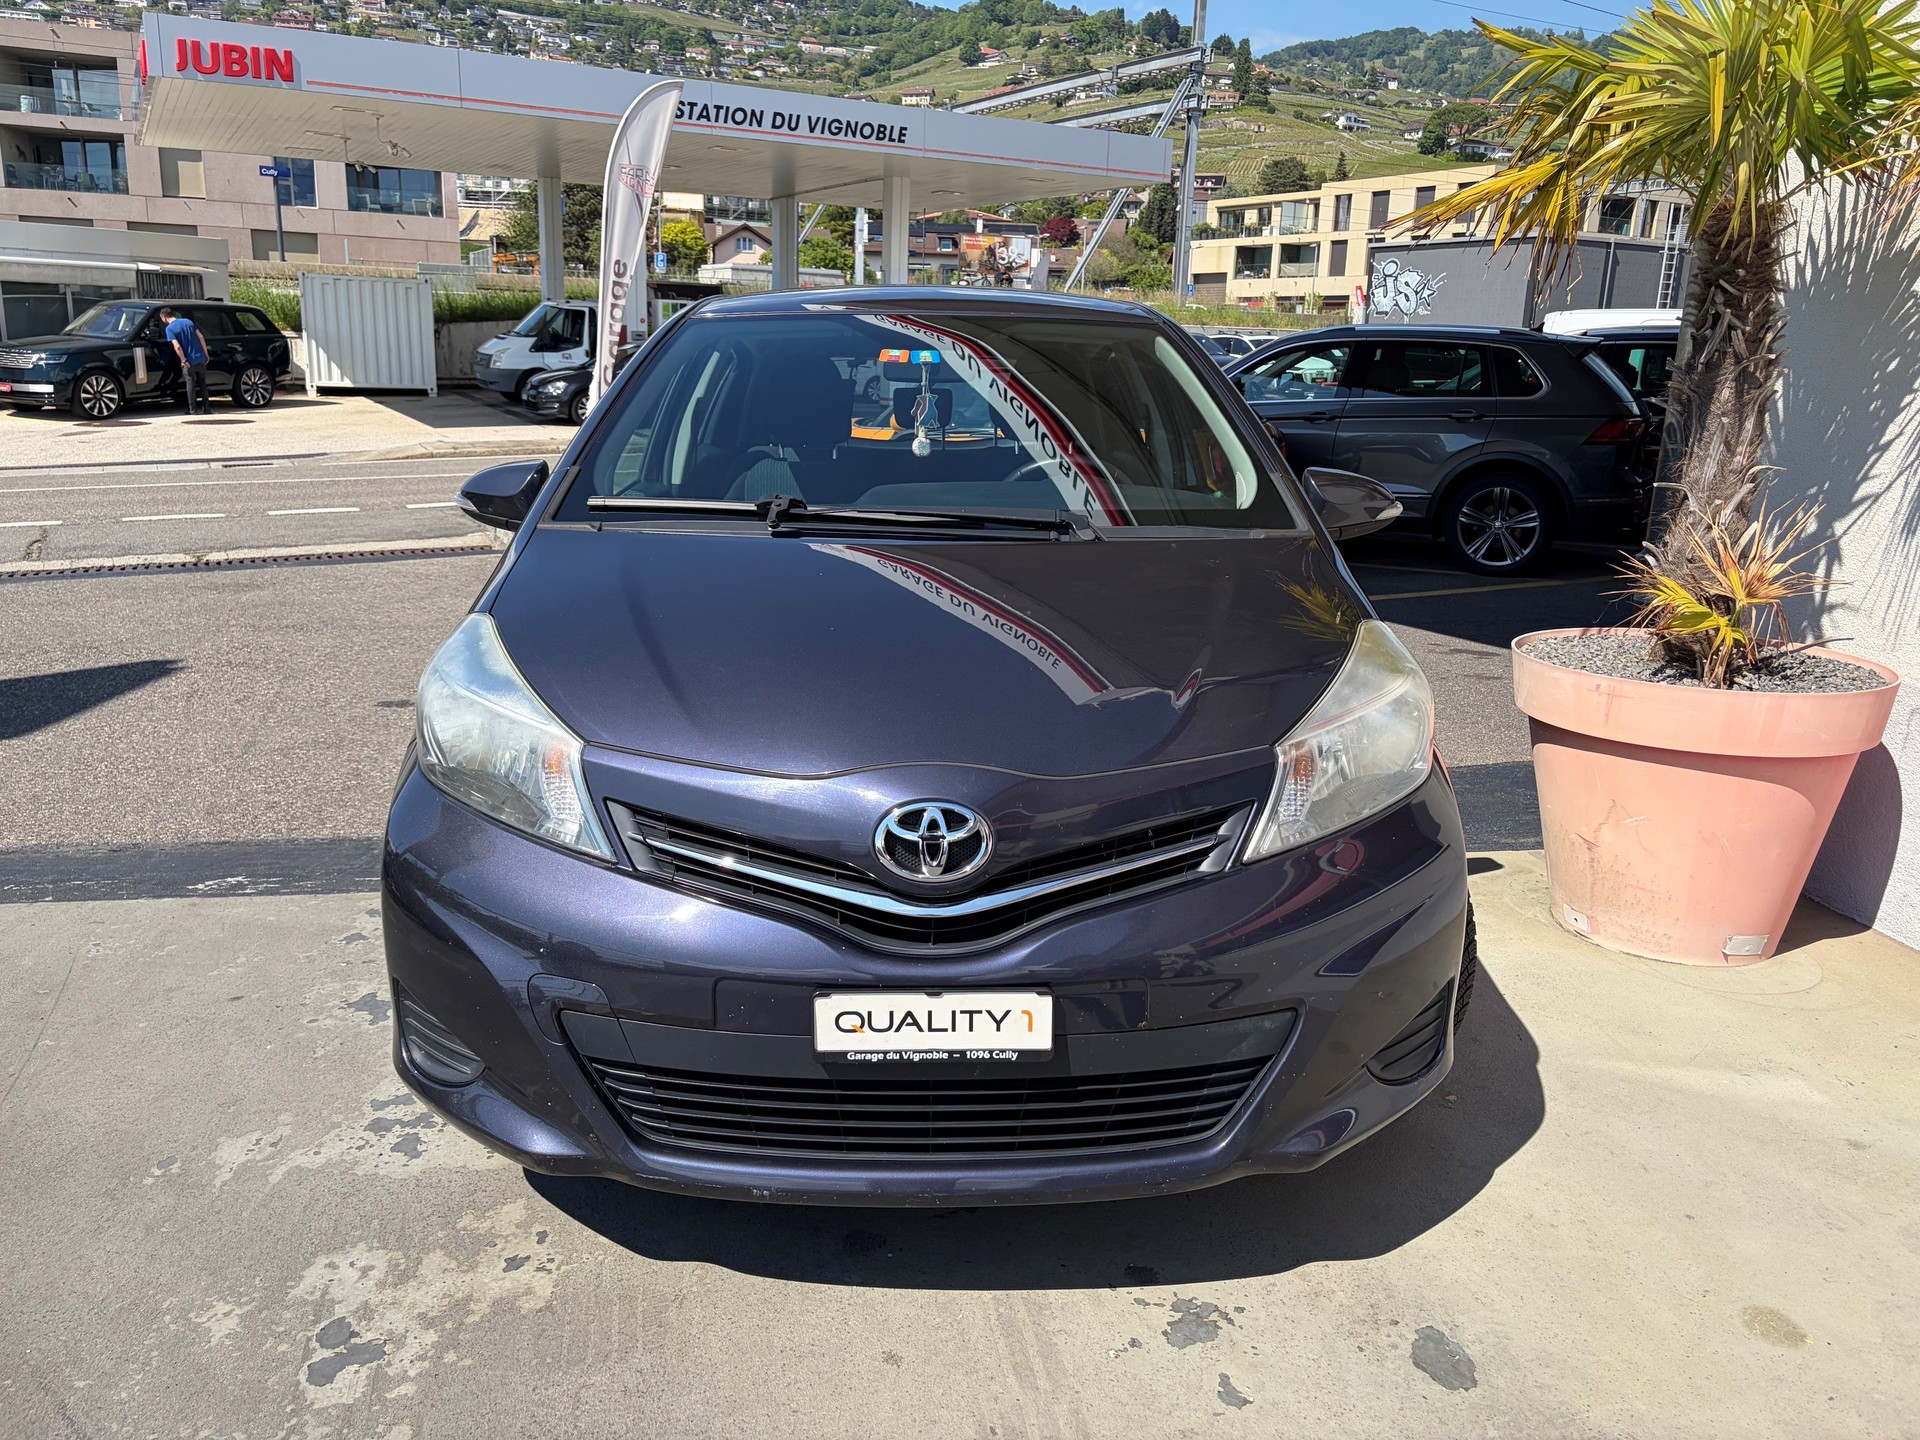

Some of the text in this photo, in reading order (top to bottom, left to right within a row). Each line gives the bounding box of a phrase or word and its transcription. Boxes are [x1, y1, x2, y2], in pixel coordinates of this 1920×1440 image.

[176, 38, 295, 82] JUBIN
[675, 100, 909, 144] STATION DU VIGNOBLE
[261, 168, 278, 177] Cully
[834, 1009, 1012, 1033] QUALITY
[847, 1051, 884, 1062] Garage
[886, 1051, 899, 1060] du
[902, 1051, 949, 1062] Vignoble
[966, 1050, 991, 1060] 1096
[992, 1050, 1018, 1061] Cully
